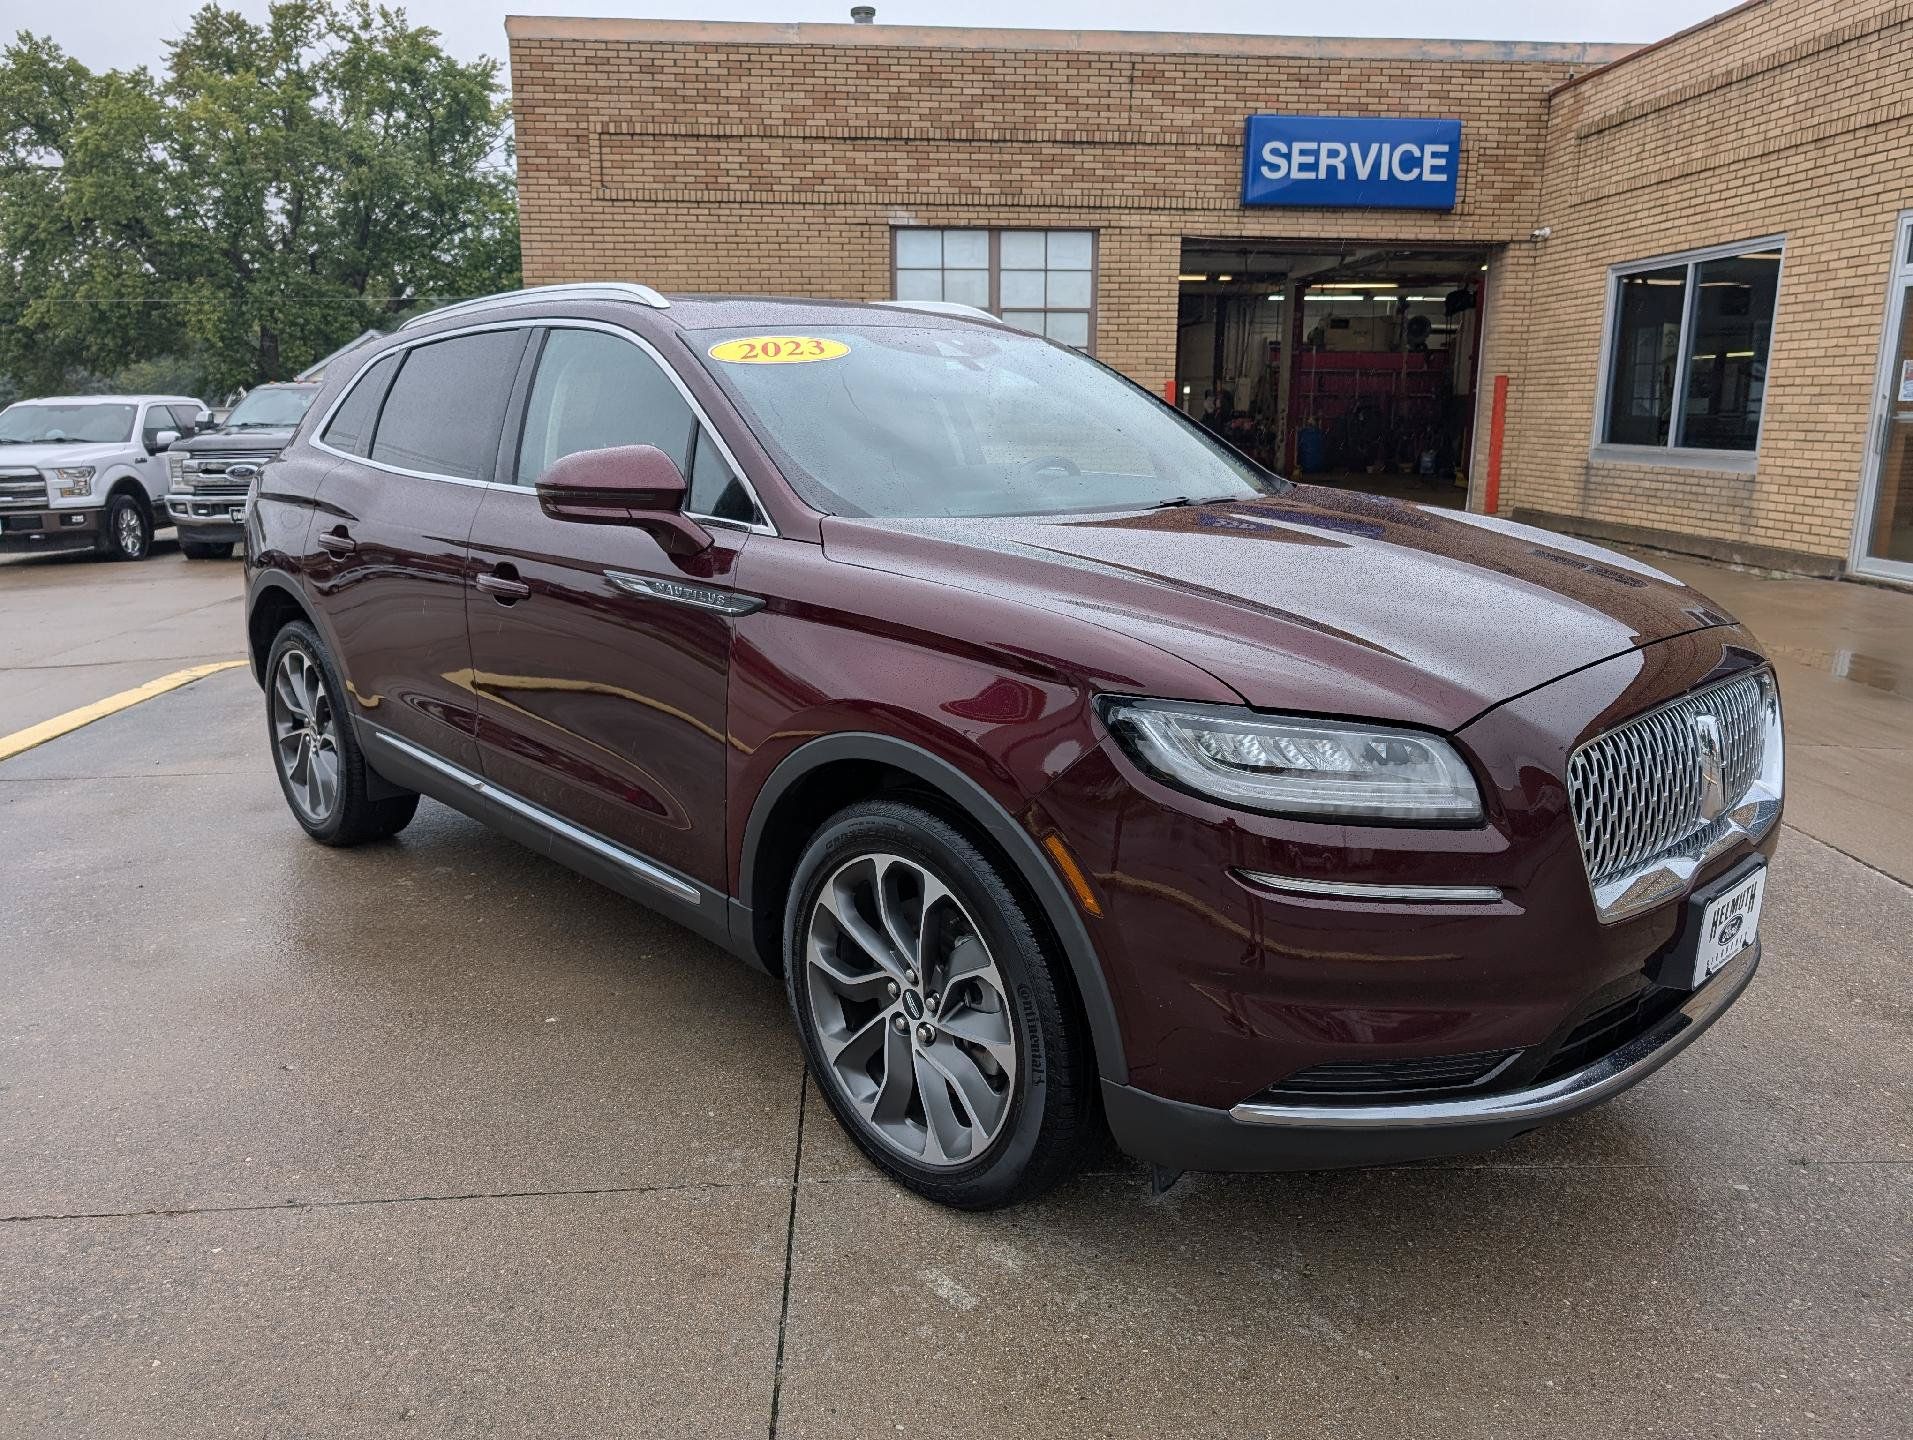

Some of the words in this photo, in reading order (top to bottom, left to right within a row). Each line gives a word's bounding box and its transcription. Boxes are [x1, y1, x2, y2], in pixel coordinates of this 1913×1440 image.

[1260, 141, 1450, 182] SERVICE
[738, 340, 825, 360] 2023
[655, 582, 725, 606] NAUTILUS
[1709, 881, 1757, 942] HELMUTH
